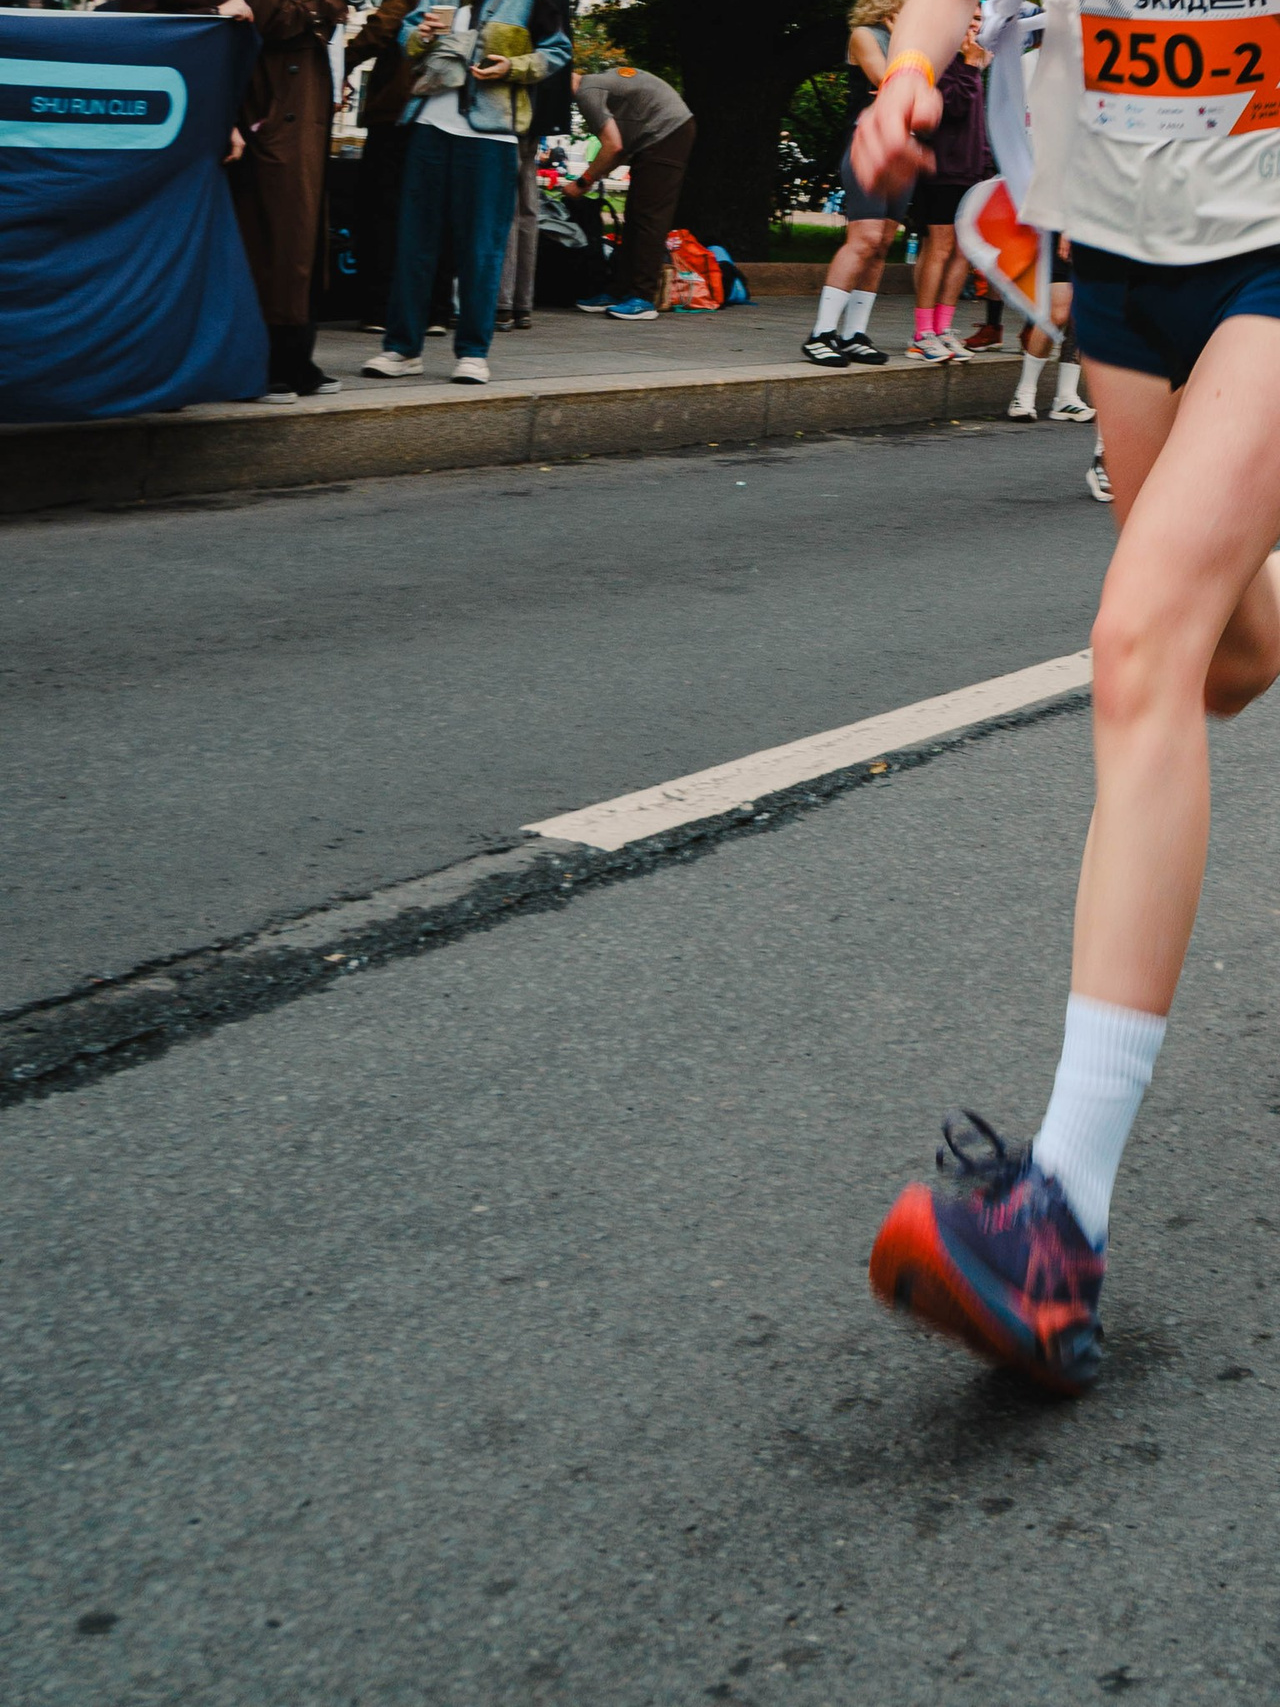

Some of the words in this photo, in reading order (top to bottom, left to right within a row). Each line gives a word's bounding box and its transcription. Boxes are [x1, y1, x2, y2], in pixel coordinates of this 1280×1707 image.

[1094, 29, 1265, 89] 250-2
[31, 96, 68, 114] SHU
[71, 98, 105, 115] RUN
[108, 99, 148, 116] CLUB
